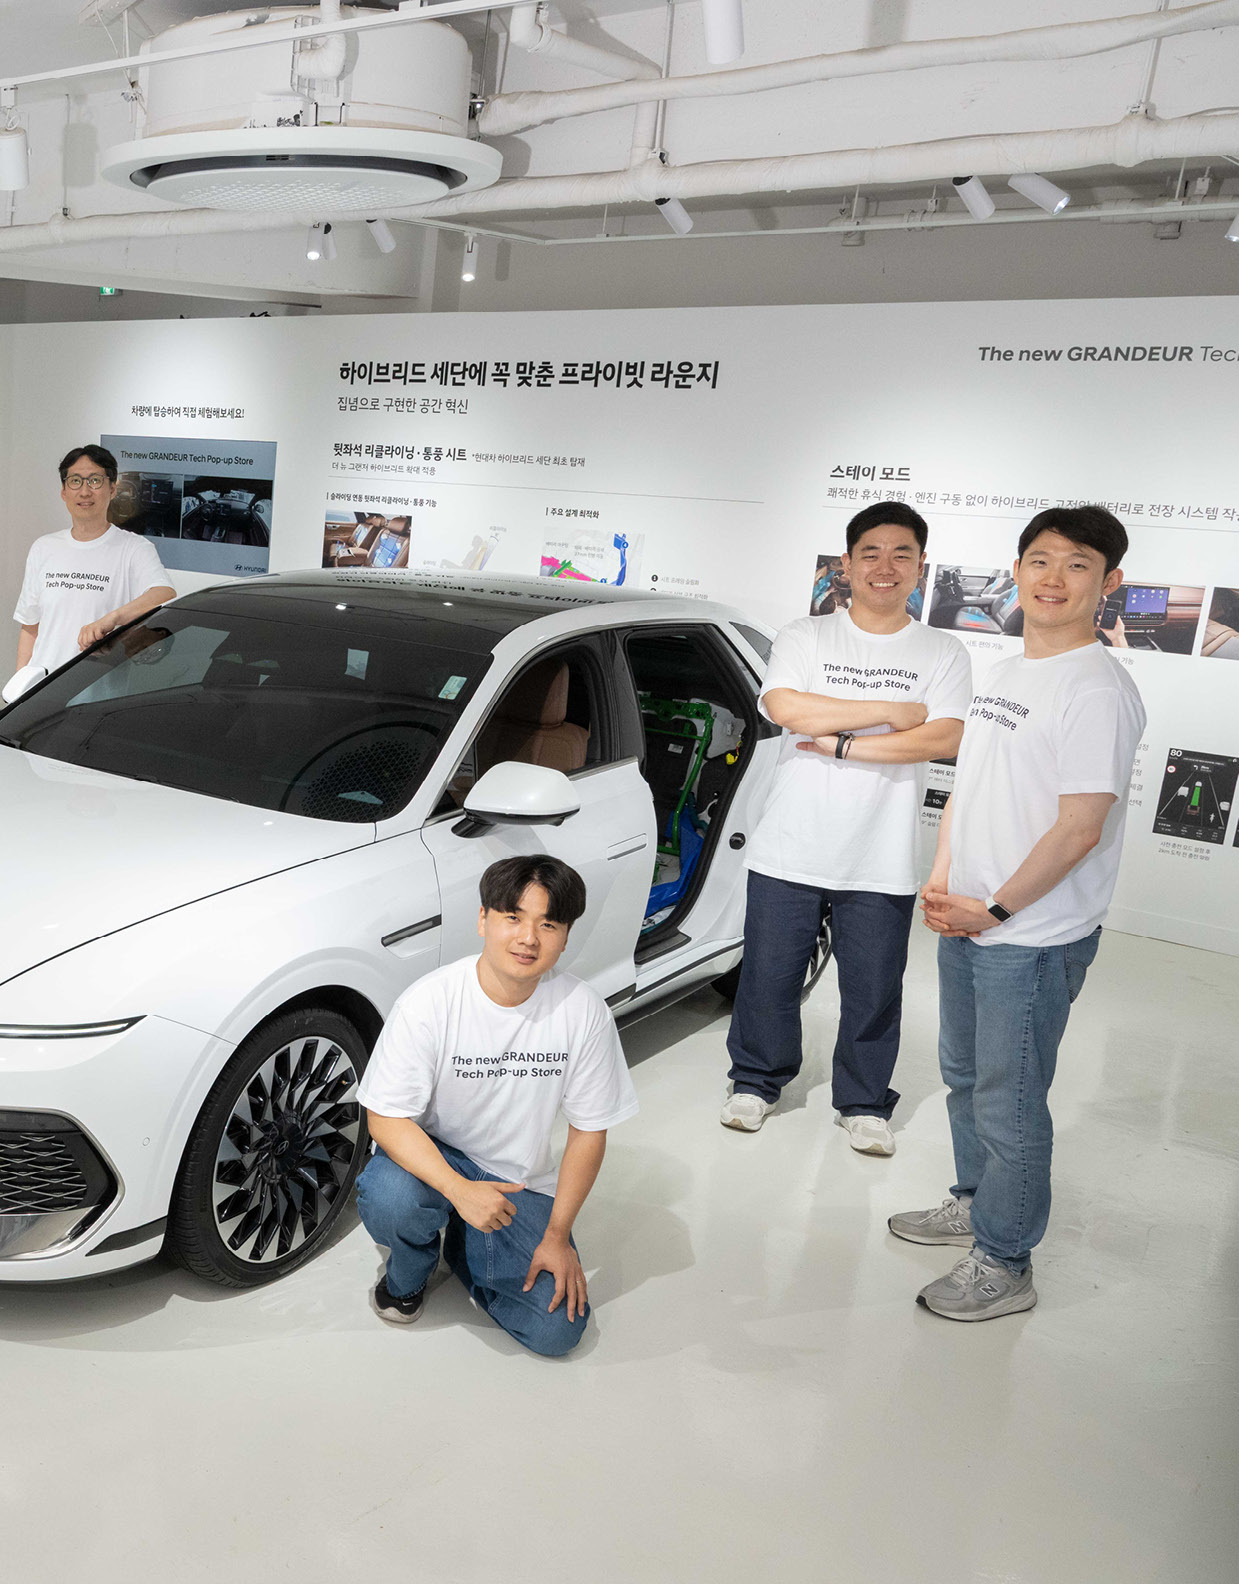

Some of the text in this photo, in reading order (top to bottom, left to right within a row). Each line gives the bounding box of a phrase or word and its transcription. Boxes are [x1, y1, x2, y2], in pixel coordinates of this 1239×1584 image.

[979, 345, 1239, 362] The new GRANDEUR Tec
[339, 361, 720, 389] 하이브리드 세단에 꼭 맞춘 프라이빗 라운지
[131, 405, 245, 419] 차량에 탑승하여 직접 체험해보세요!
[337, 397, 469, 415] 집념으로 구현한 공간 혁신
[121, 451, 132, 459] The
[149, 452, 188, 461] GRANDEUR
[189, 454, 206, 462] Tech
[207, 455, 233, 465] Pop-up
[234, 456, 254, 465] Store
[333, 443, 467, 461] 뒷좌석 리클라이닝 통풍 시트
[498, 454, 534, 464] 하이브리드
[536, 456, 551, 465] 세단
[569, 457, 585, 467] 탑재
[829, 464, 911, 481] 스테이 모드
[827, 487, 859, 500] 쾌적한
[860, 488, 882, 501] 휴식
[884, 489, 907, 503] 경험
[914, 491, 937, 505] 엔진
[939, 493, 962, 506] 구동
[965, 494, 988, 507] 없이
[991, 495, 1050, 510] 하이브리드
[1148, 504, 1175, 518] 전장
[1177, 505, 1218, 521] 시스템
[1222, 508, 1239, 522] 작
[550, 507, 599, 519] 주요 설계 최적화
[71, 572, 110, 583] GRANDEUR
[60, 581, 85, 590] Pop-up
[86, 583, 104, 591] Store
[823, 663, 918, 681] The new GRANDEUR
[826, 675, 911, 692] Tech Pop-up Store
[994, 697, 1030, 719] GRANDEUR
[1170, 749, 1182, 757] 80
[452, 1052, 569, 1065] The new GRANDEUR
[455, 1067, 562, 1078] Tech Pop-up Store
